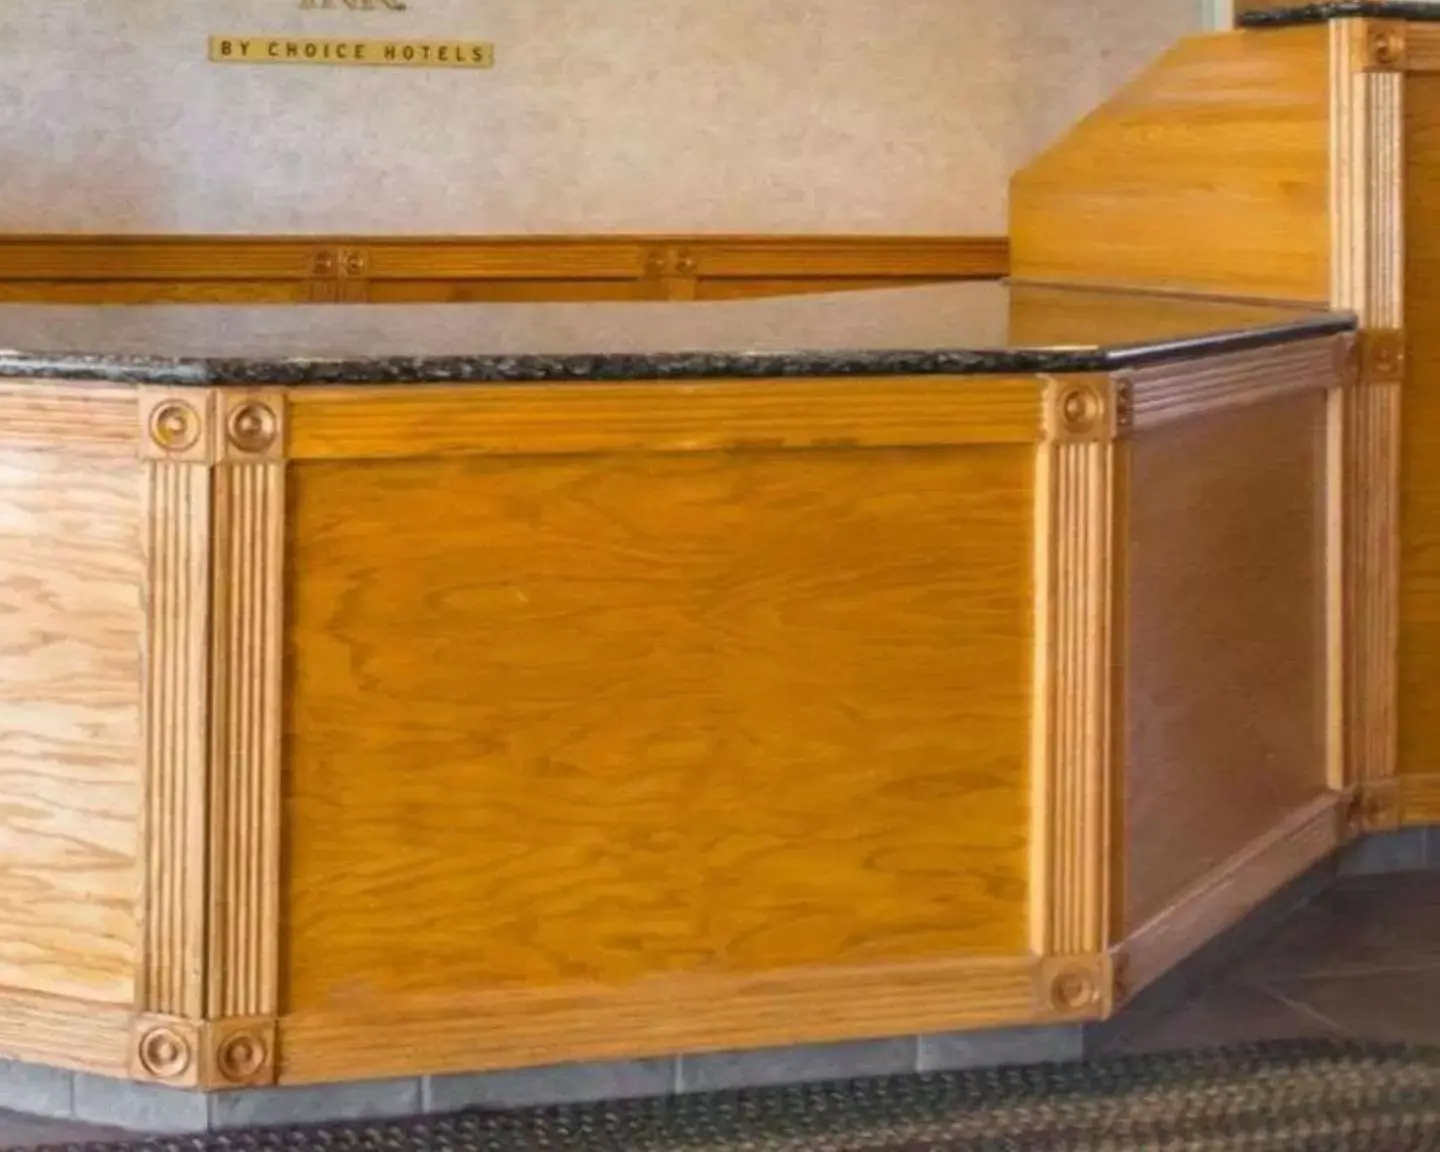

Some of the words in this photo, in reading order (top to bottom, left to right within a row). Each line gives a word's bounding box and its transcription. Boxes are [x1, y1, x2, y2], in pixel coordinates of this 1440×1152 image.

[220, 39, 251, 56] BY
[267, 40, 365, 60] CHOICE
[383, 44, 484, 63] HOTELS
